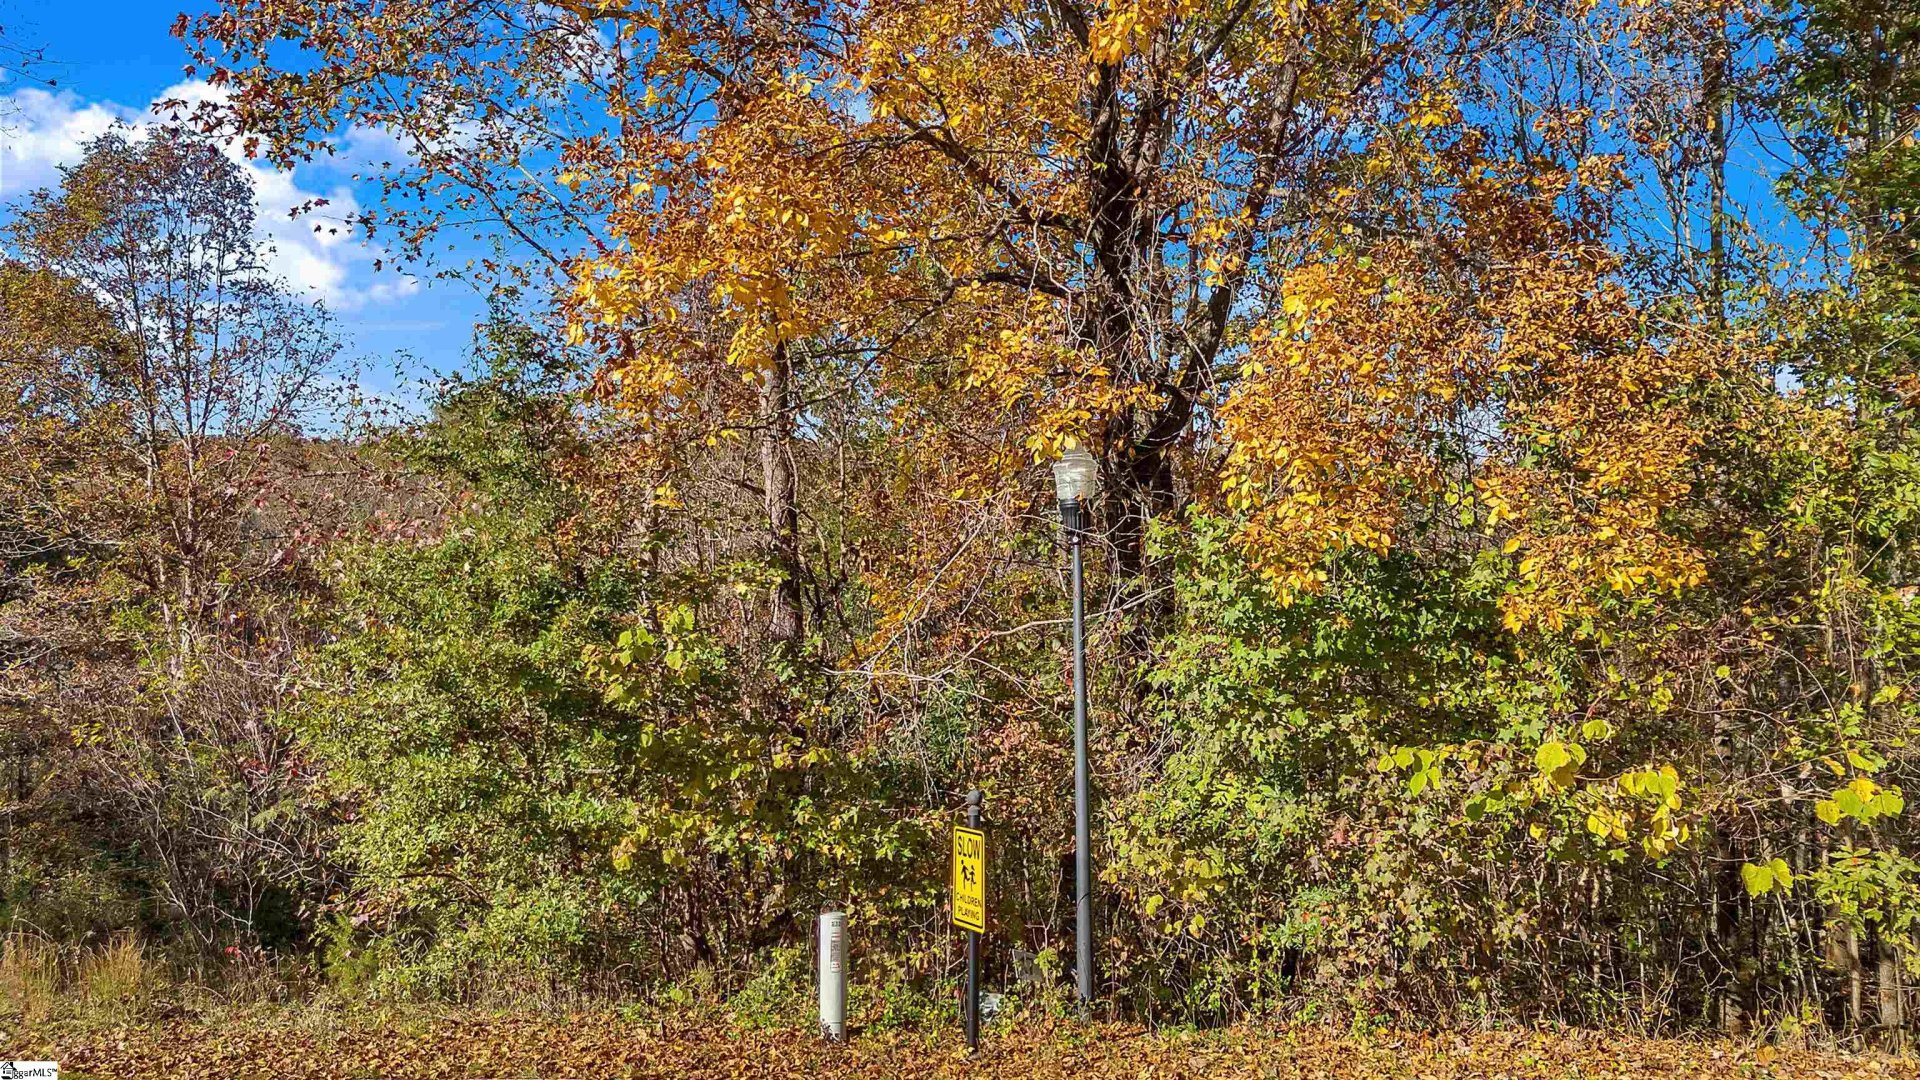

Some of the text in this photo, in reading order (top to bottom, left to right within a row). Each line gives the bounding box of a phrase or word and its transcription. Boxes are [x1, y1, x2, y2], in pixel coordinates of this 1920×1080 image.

[958, 835, 980, 860] SLOW
[956, 892, 982, 908] CHILDREN
[958, 905, 980, 920] PLAYING
